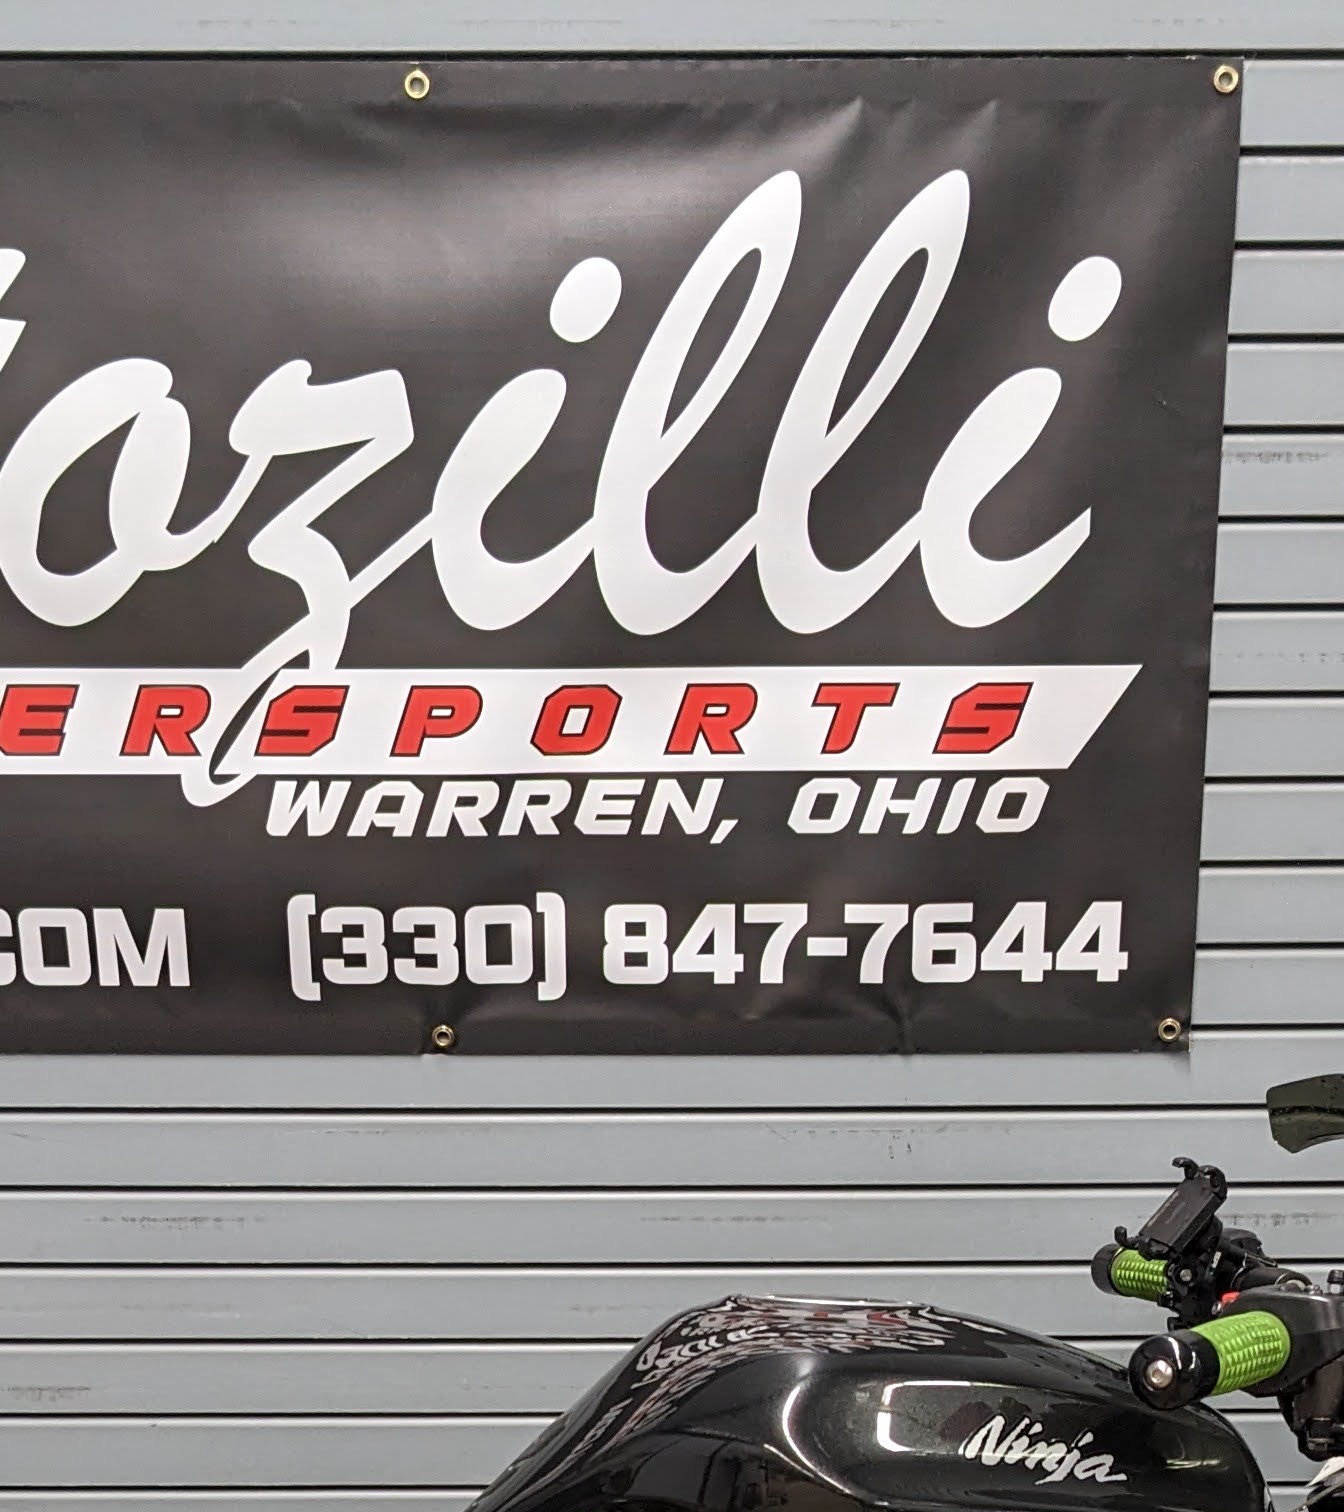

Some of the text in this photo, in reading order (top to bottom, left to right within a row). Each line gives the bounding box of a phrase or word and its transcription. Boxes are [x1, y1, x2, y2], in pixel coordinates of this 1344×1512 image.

[265, 776, 1050, 845] WARREN, OHIO
[286, 891, 567, 1002] (330)
[602, 900, 1129, 985] 847-7644
[958, 1415, 1128, 1485] Ninja
